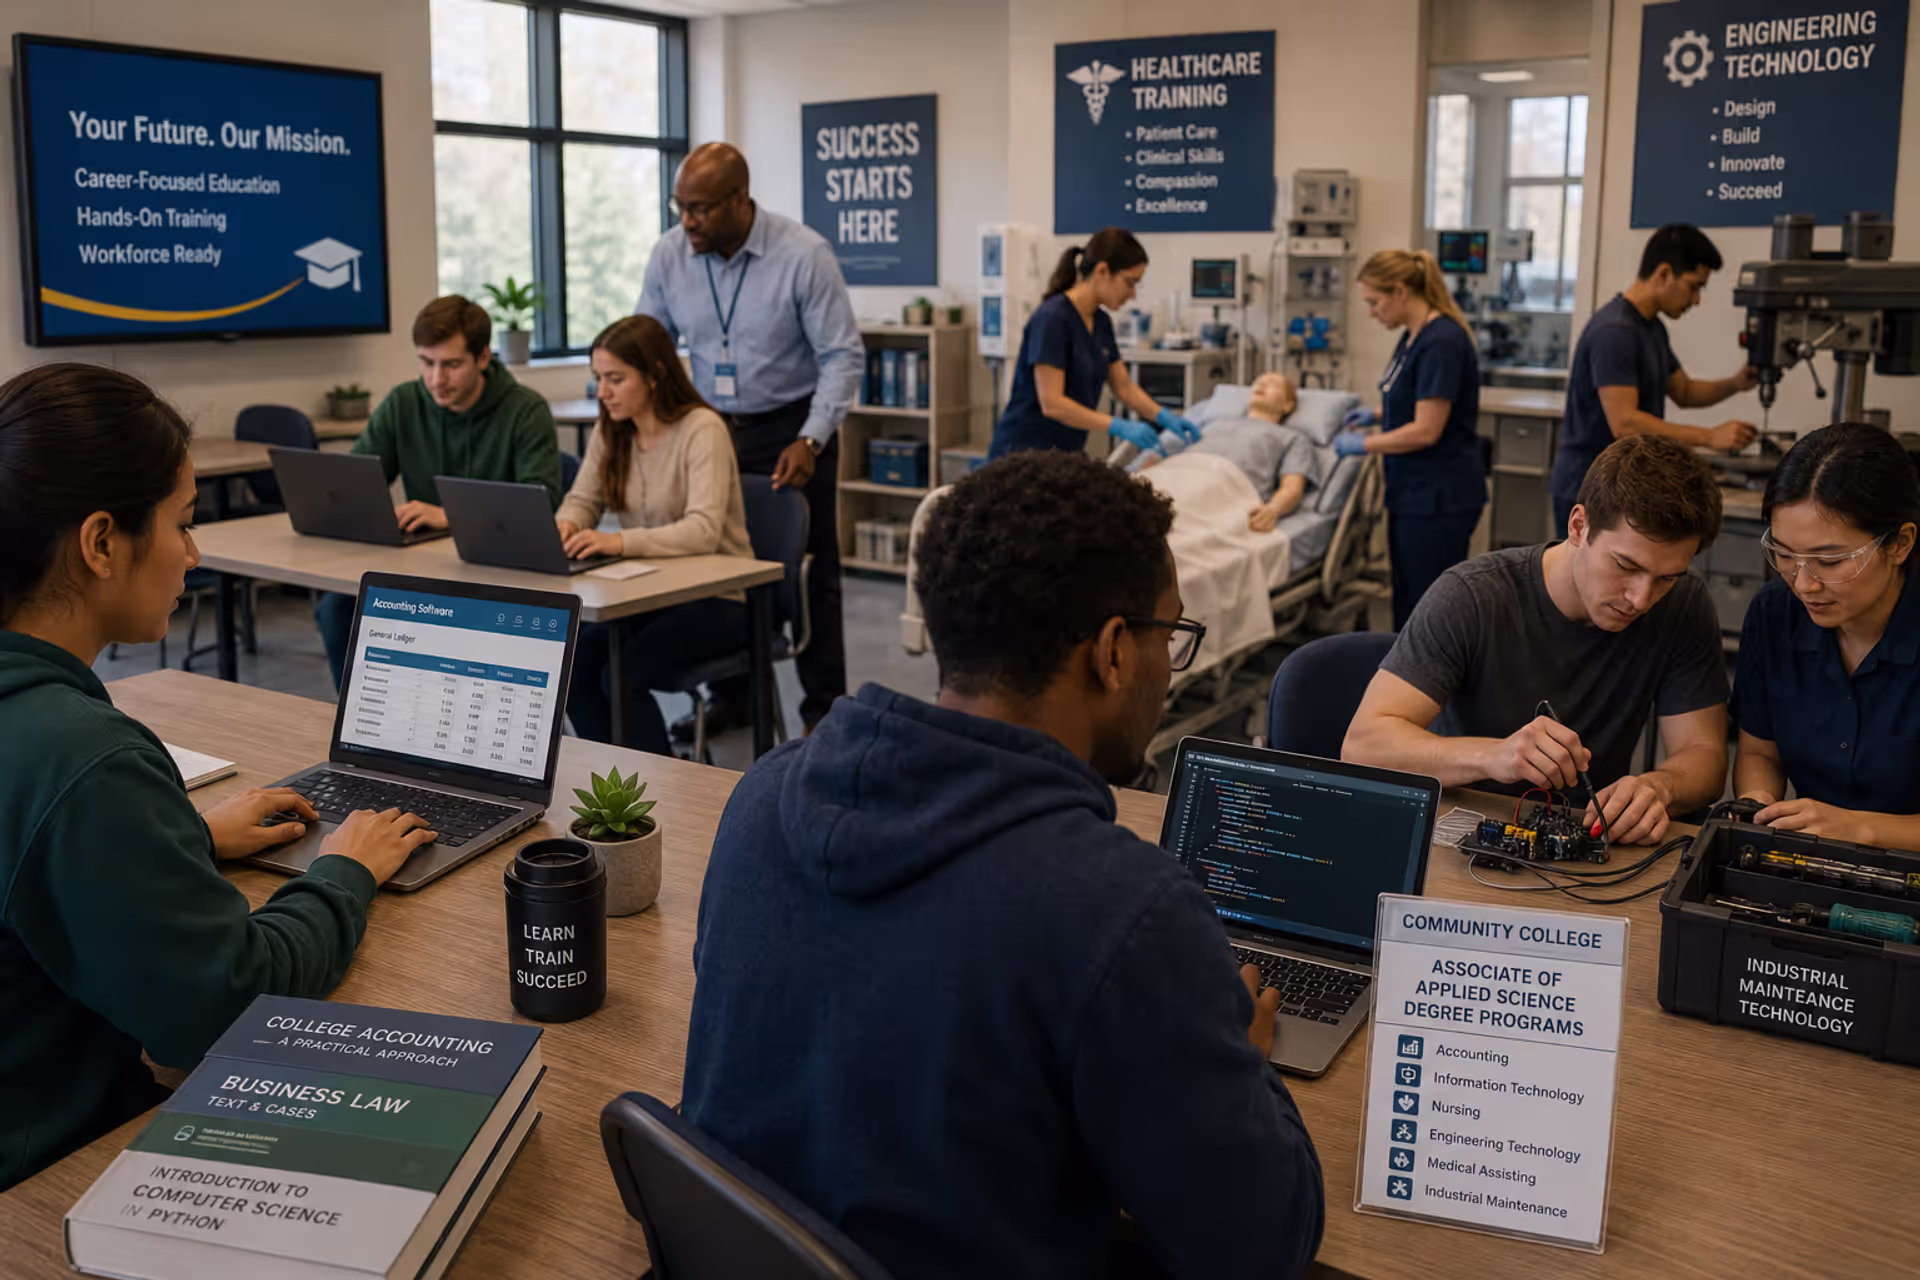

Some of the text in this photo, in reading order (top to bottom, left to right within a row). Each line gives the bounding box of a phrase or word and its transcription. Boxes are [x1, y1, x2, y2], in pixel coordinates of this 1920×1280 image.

[1725, 10, 1877, 48] ENGINEERING
[1131, 51, 1262, 81] HEALTHCARE
[1724, 43, 1876, 79] TECHNOLOGY
[1132, 84, 1228, 110] TRAINING
[1724, 98, 1776, 119] Design
[69, 110, 351, 156] Your Future. Our Mission.
[816, 122, 920, 161] SUCCESS
[1136, 124, 1218, 142] Patient Care
[1722, 126, 1760, 145] Build
[1136, 147, 1224, 165] Clinical Skills
[1720, 154, 1785, 172] Innovate
[74, 168, 280, 194] Career-Focused Education
[826, 165, 913, 202] STARTS
[1135, 172, 1218, 192] Compassion
[1718, 181, 1783, 200] Succeed
[77, 206, 227, 233] Hands-On Training
[1136, 196, 1208, 214] Excellence
[839, 208, 899, 244] HERE
[79, 244, 222, 267] Workforce Ready
[373, 597, 454, 618] Accounting Software
[523, 924, 575, 941] LEARN
[1402, 913, 1603, 949] COMMUNITY COLLEGE
[525, 948, 574, 965] TRAIN
[517, 969, 587, 989] SUCCEED
[1431, 959, 1562, 988] ASSOCIATE OF
[1747, 957, 1849, 990] INDUSTRIAL
[1415, 980, 1576, 1013] APPLIED SCIENCE
[1739, 978, 1855, 1014] MAINTEANCE
[1404, 1001, 1584, 1037] DEGREE PROGRAMS
[1739, 1000, 1853, 1035] TECHNOLOGY
[266, 1016, 494, 1055] COLLEGE ACCOUNTING
[277, 1036, 459, 1069] A PRACTICAL APPROACH
[1436, 1045, 1509, 1067] Accounting
[220, 1075, 410, 1115] BUSINESS LAW
[1434, 1072, 1585, 1106] Information Technology
[207, 1095, 317, 1120] TEXT & CASES
[1431, 1100, 1481, 1120] Nursing
[1429, 1129, 1581, 1164] Engineering Technology
[150, 1165, 309, 1199] INTRODUCTION TO
[1427, 1157, 1537, 1186] Medical Assisting
[120, 1202, 225, 1232] IN PYTHON
[133, 1183, 342, 1227] COMPUTER SCIENCE
[1425, 1185, 1568, 1219] Industrial Maintenance
